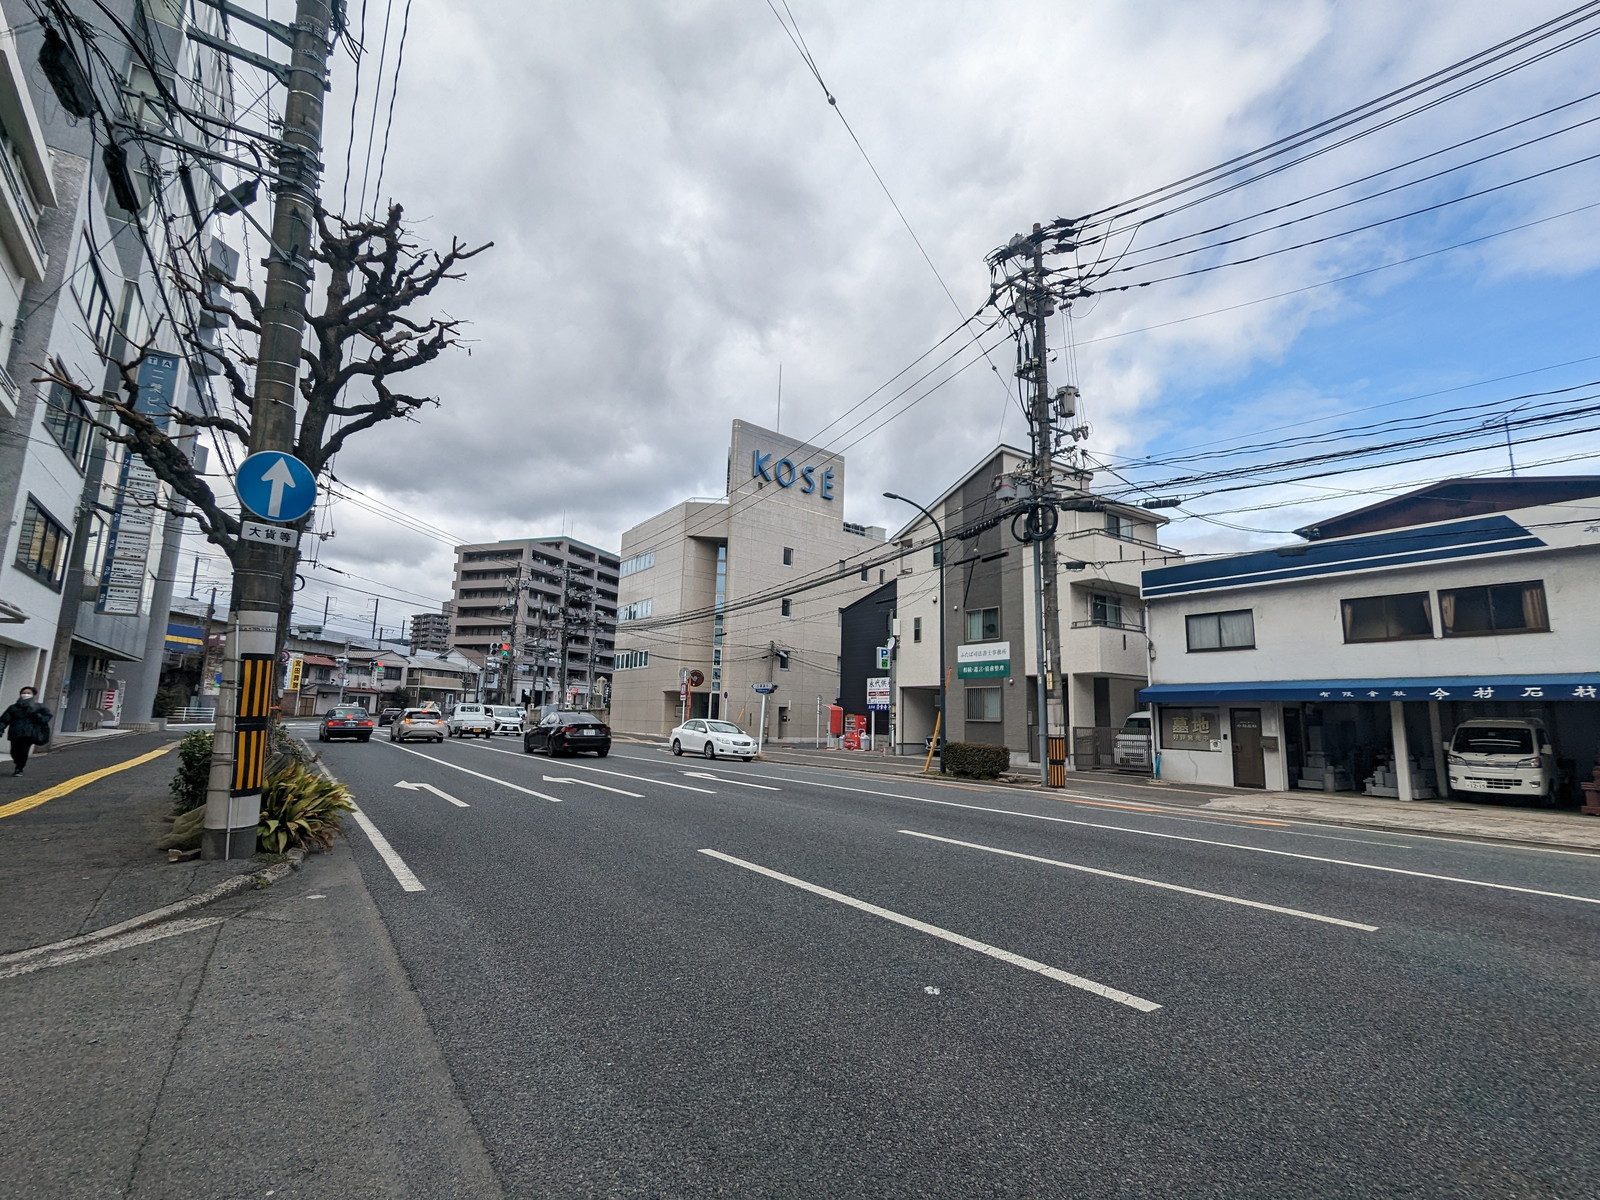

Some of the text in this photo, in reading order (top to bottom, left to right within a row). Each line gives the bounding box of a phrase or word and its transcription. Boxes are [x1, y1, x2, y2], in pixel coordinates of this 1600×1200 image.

[753, 449, 835, 500] KOSÉ
[248, 526, 292, 543] 大貨等
[881, 649, 889, 658] P
[960, 648, 1007, 657] ふたば司法書士事務所
[1319, 690, 1407, 698] 有限会社
[1428, 685, 1599, 700] 今村石材
[1172, 715, 1211, 734] 墓地
